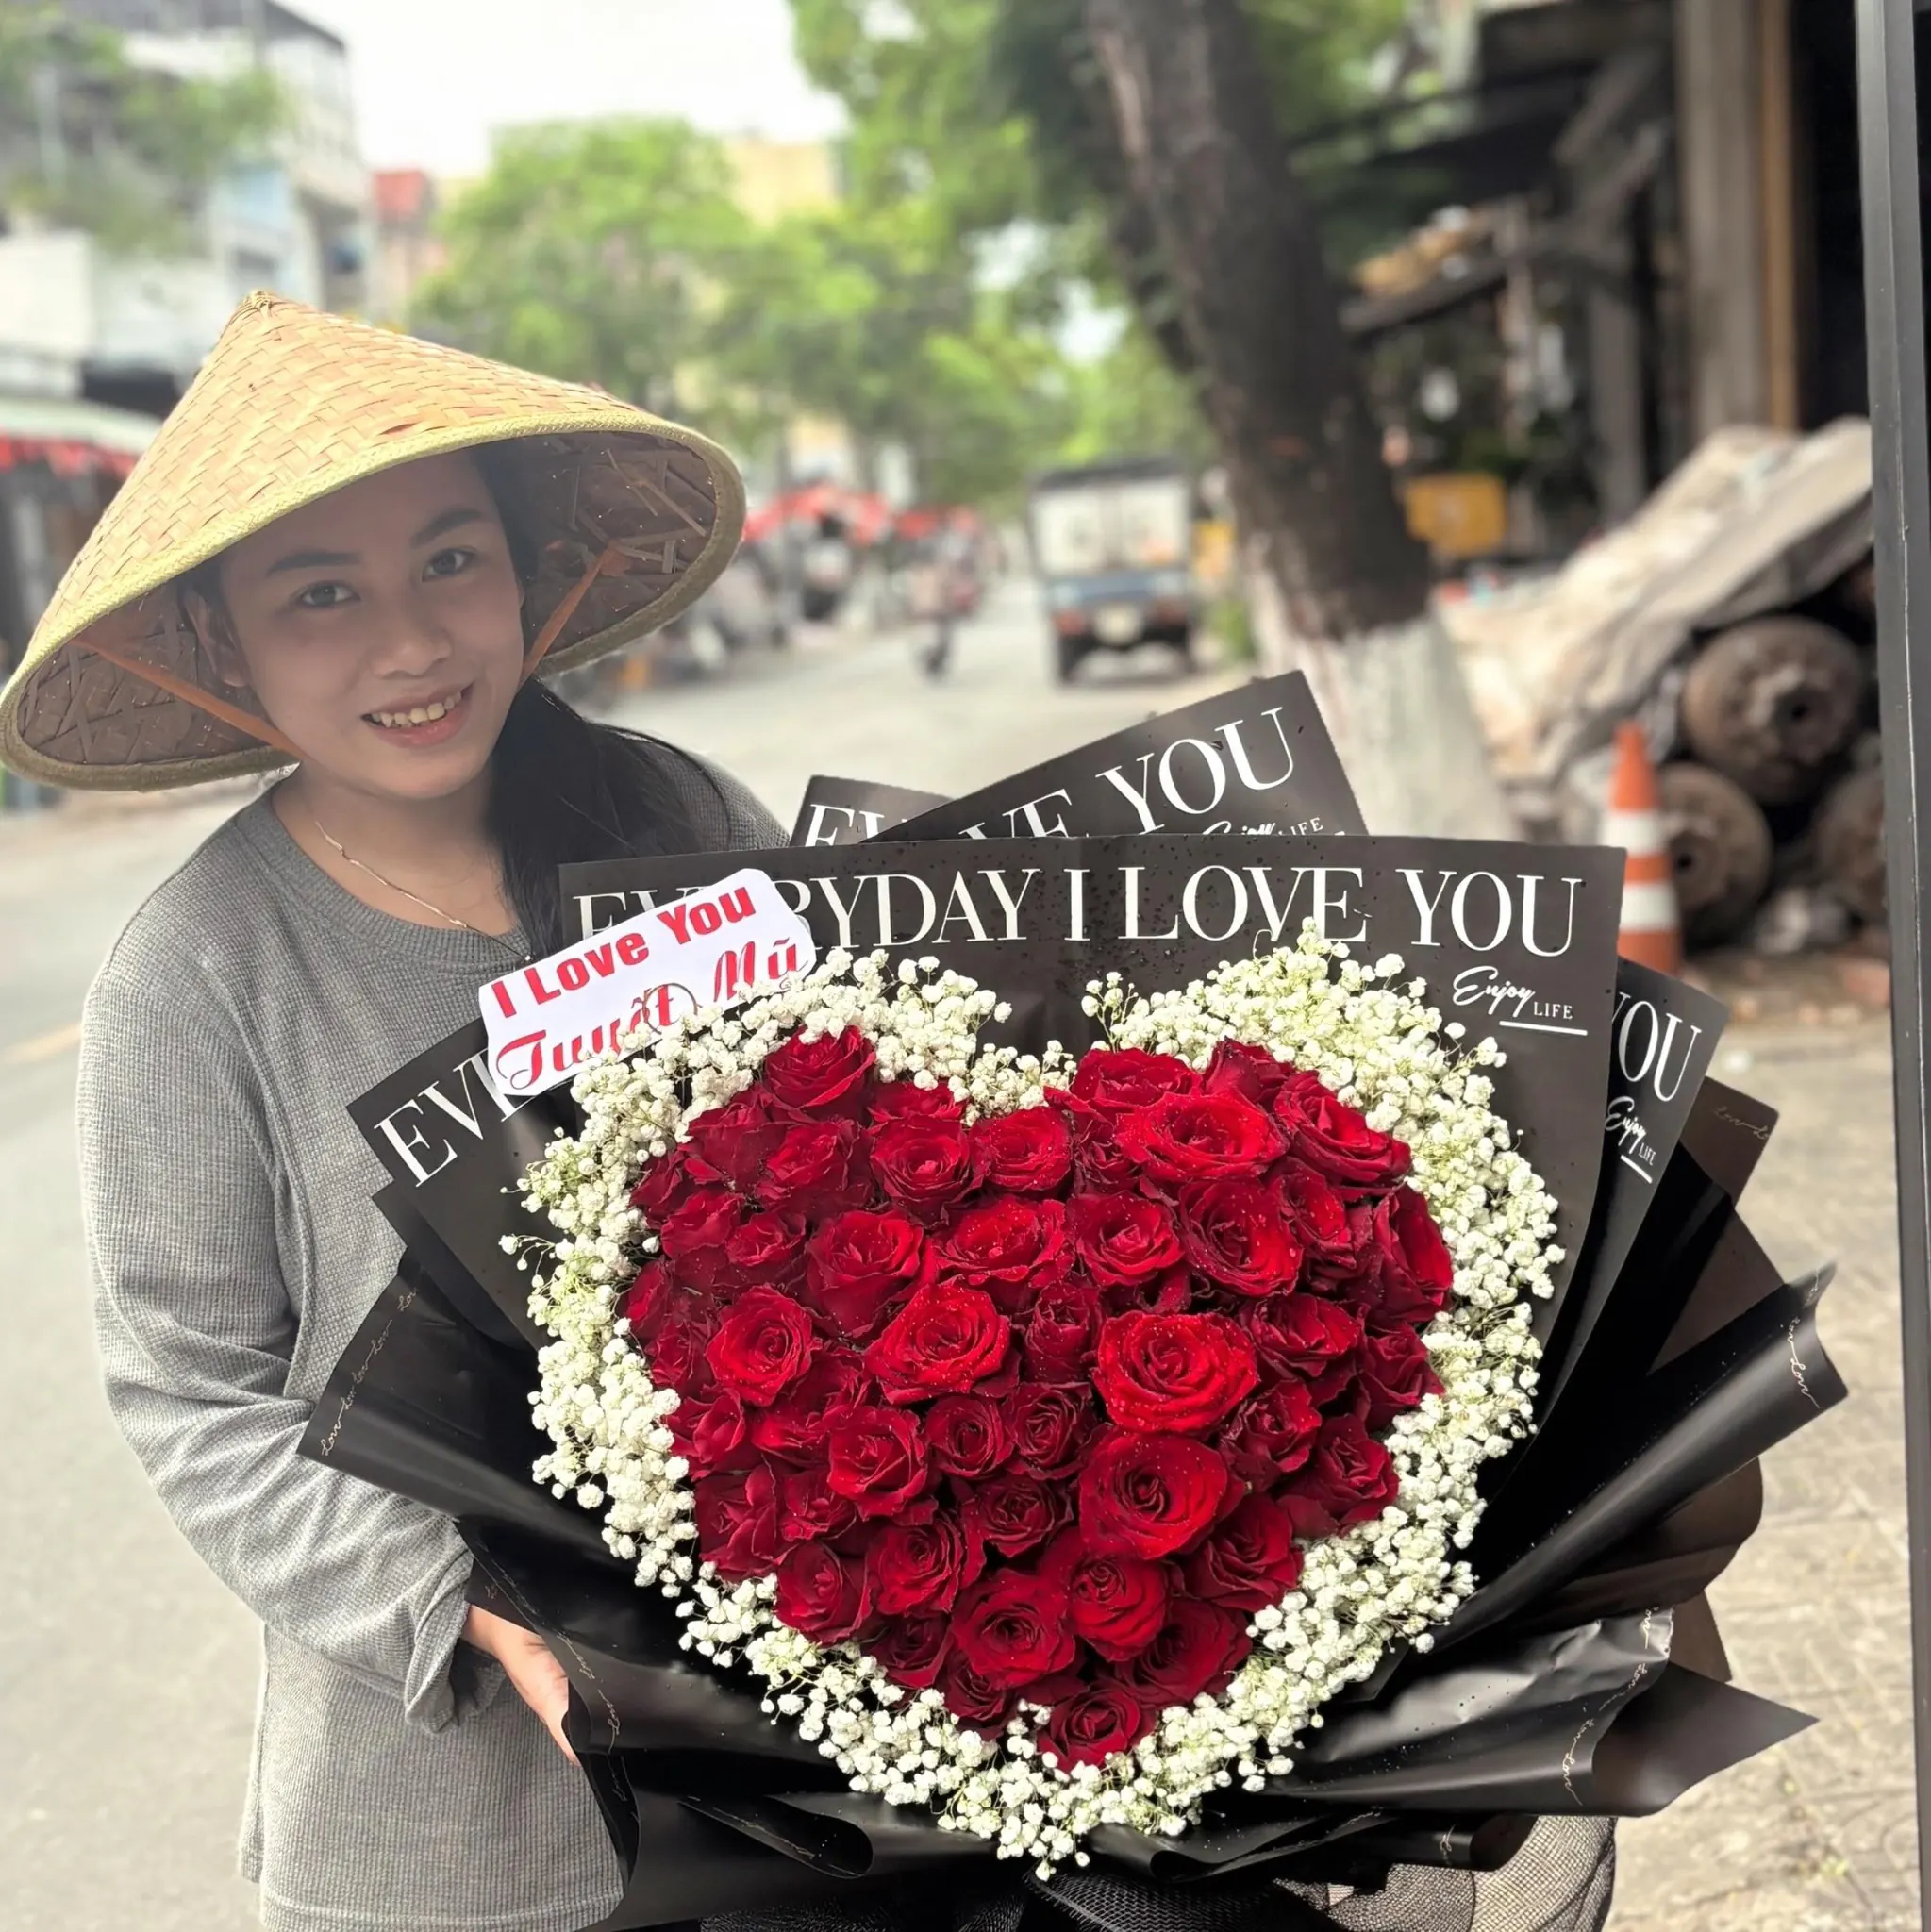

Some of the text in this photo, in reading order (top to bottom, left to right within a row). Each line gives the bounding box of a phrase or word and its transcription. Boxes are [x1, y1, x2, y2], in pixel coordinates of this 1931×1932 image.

[1094, 707, 1295, 835] YOU
[491, 886, 757, 1018] I Love You
[1063, 868, 1090, 941] I
[1118, 864, 1367, 942] LOVE
[1395, 867, 1583, 958] YOU
[1453, 965, 1573, 1020] Enjoy LIFE
[1605, 1096, 1657, 1166] Enjoy LIFE
